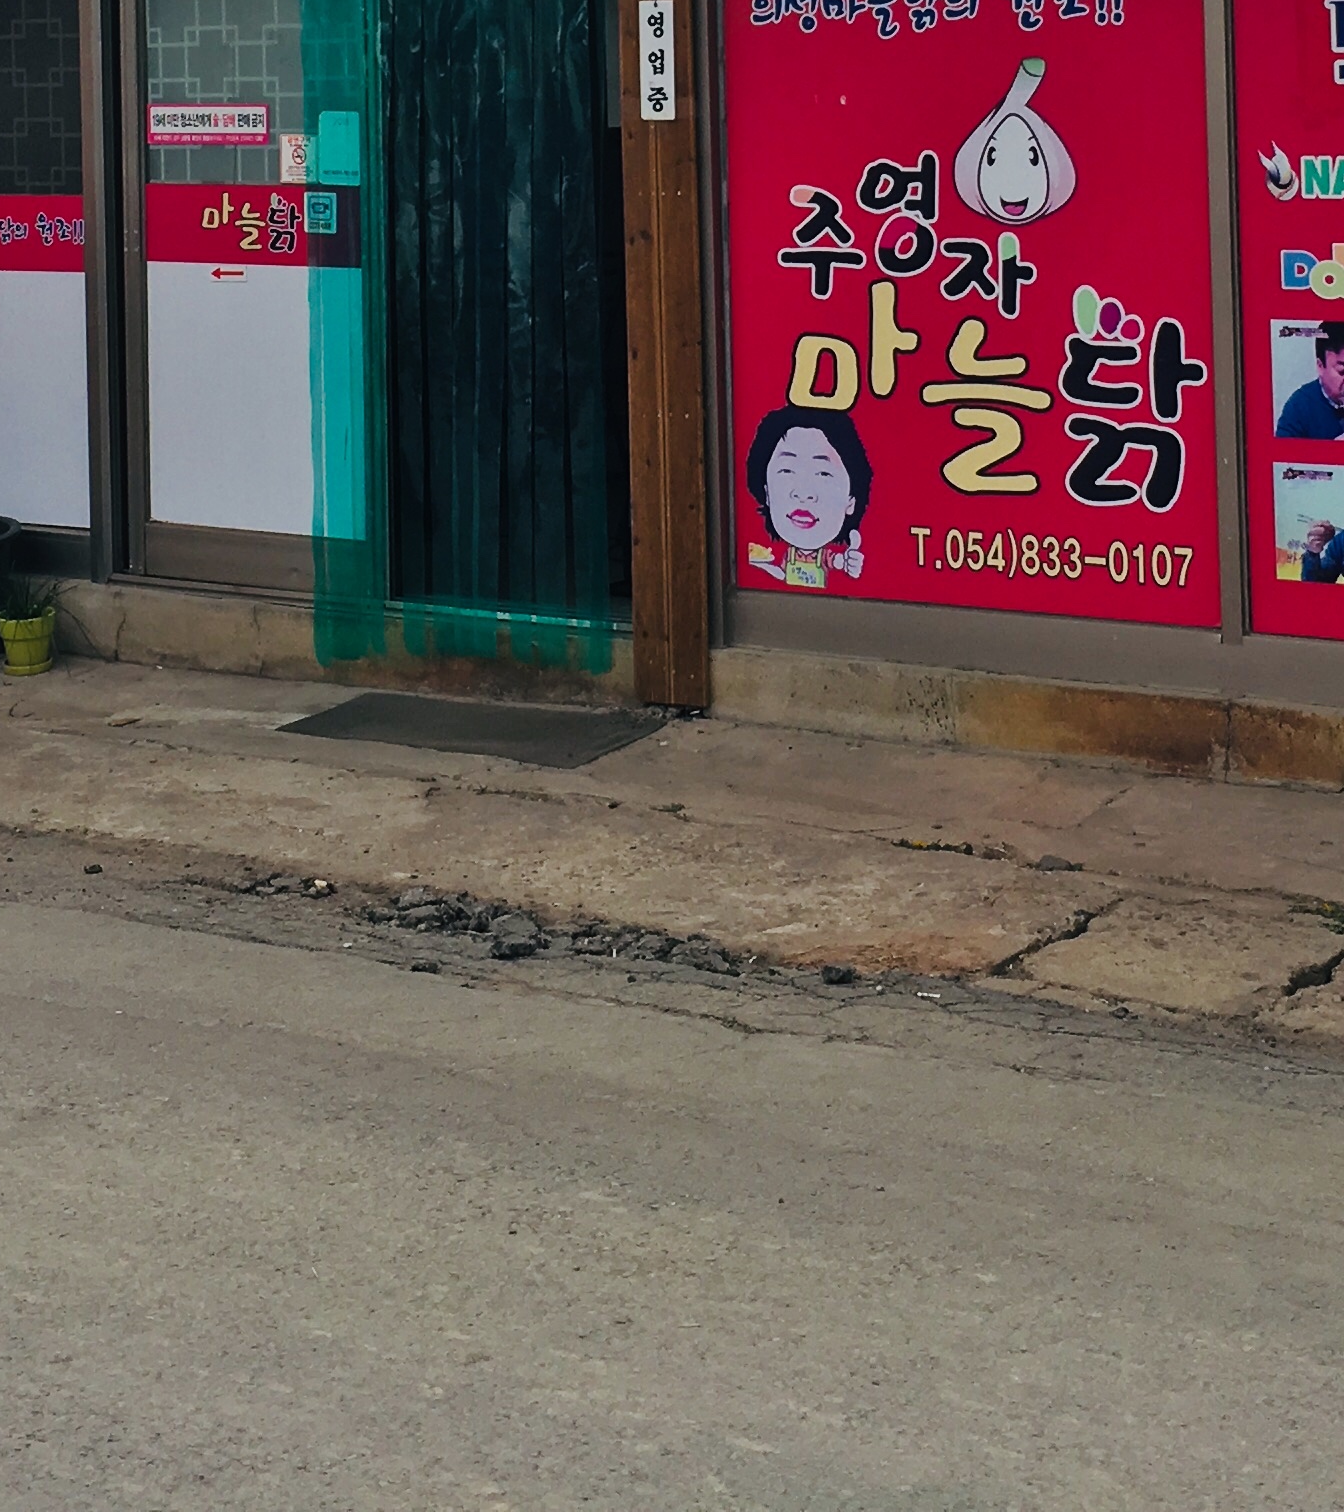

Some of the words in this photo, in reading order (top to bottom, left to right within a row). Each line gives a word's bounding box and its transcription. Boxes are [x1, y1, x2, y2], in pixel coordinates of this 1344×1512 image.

[646, 11, 669, 113] 영업중
[201, 192, 303, 254] 마늘닭
[777, 150, 1038, 319] 주영자
[785, 280, 1209, 513] 마늘닭
[909, 525, 1194, 587] T.054)833-0107
